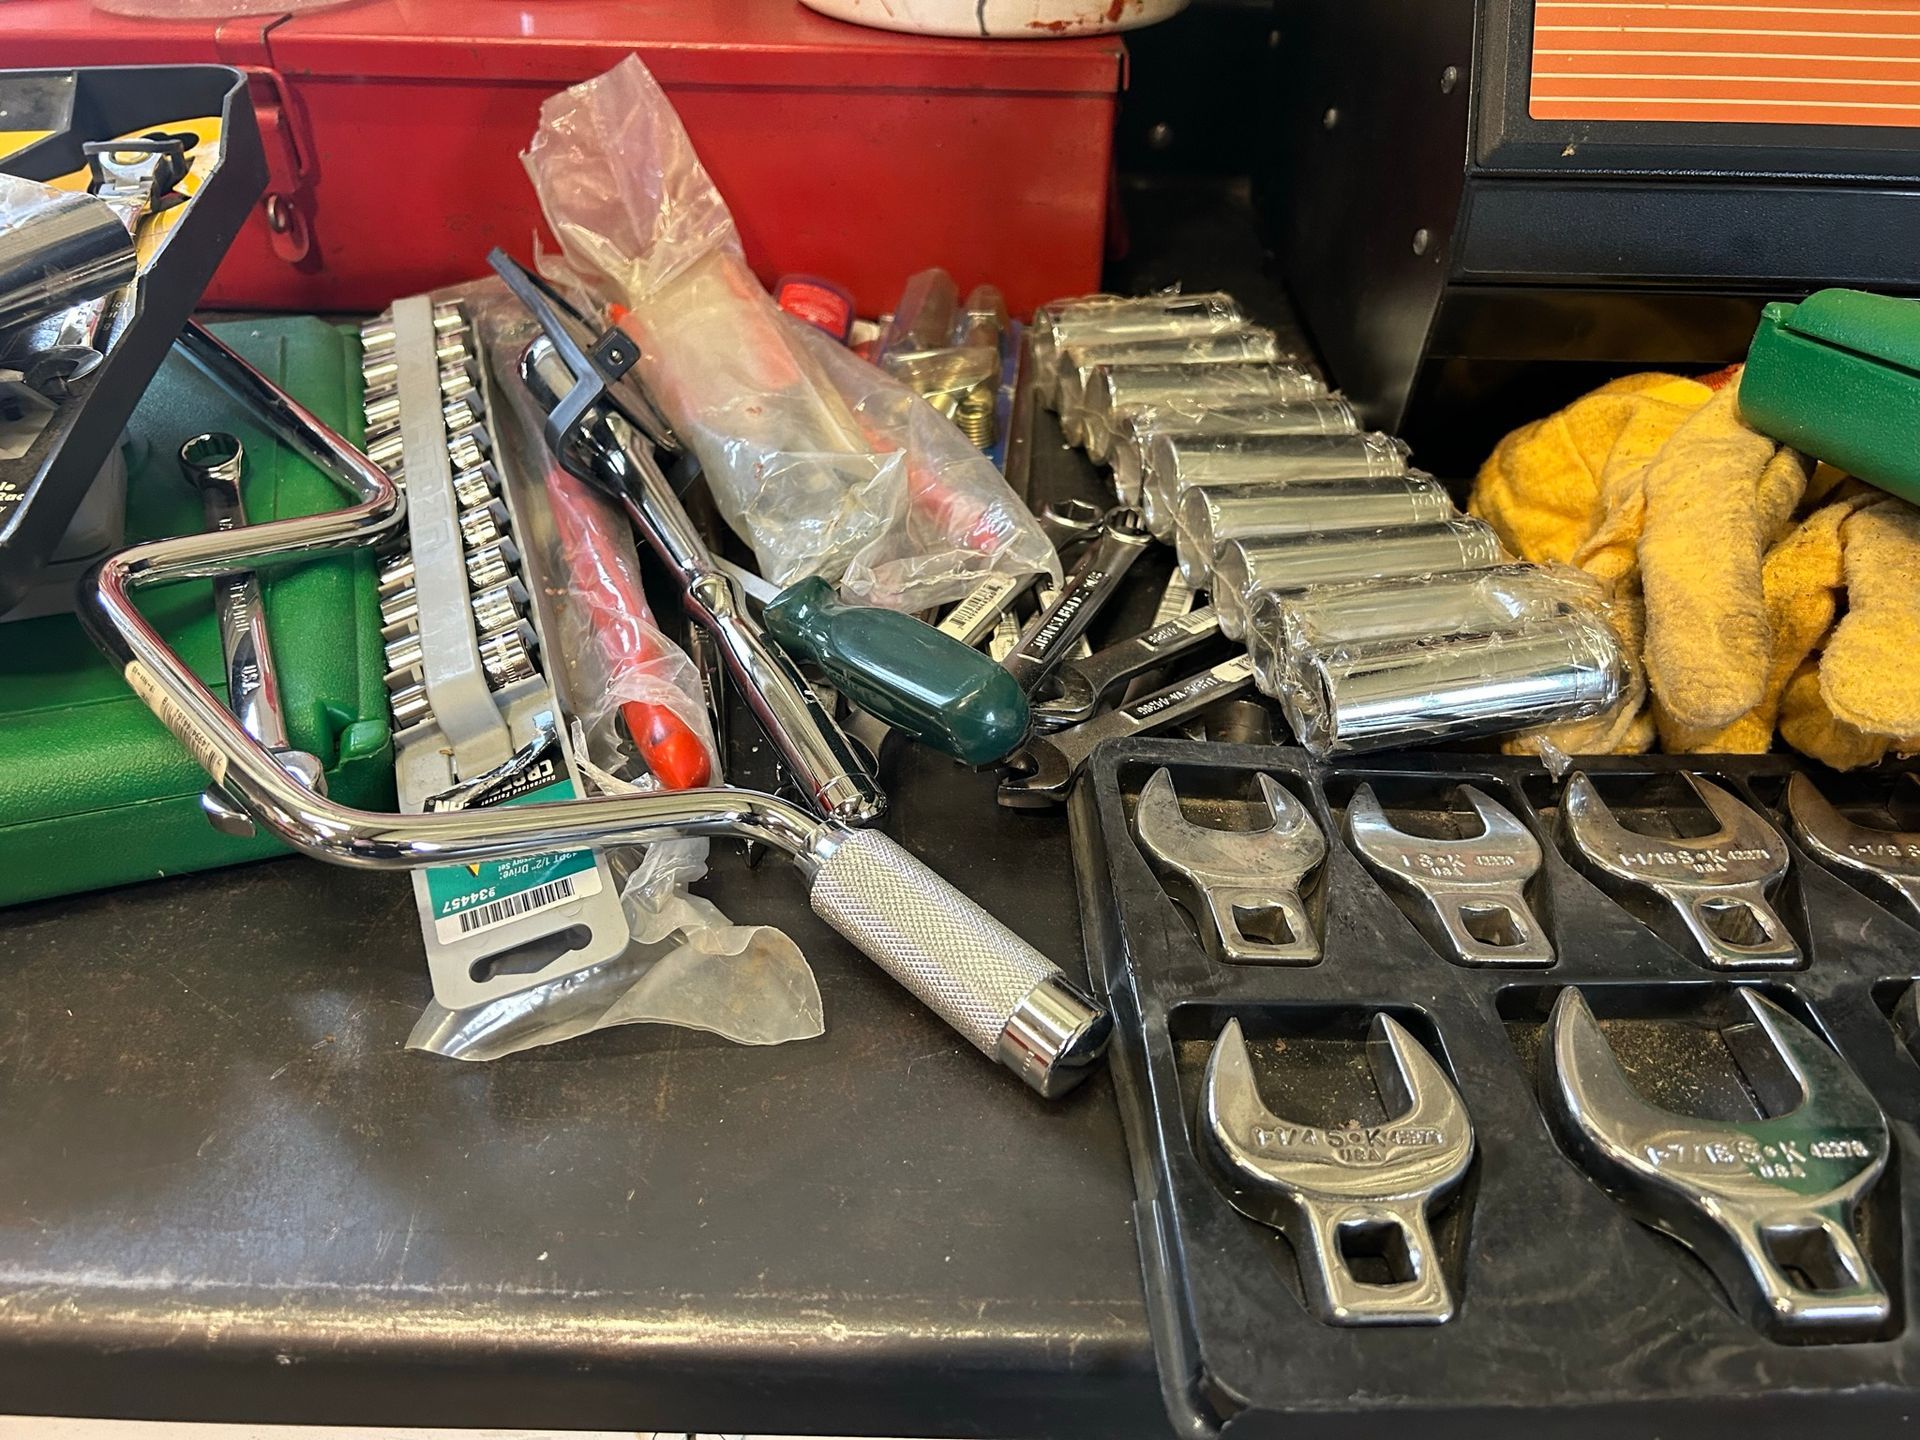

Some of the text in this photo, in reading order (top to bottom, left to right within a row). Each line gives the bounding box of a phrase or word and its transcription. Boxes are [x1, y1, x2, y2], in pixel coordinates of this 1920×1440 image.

[512, 774, 556, 795] Guaranteed
[498, 862, 511, 872] Set
[500, 864, 529, 880] Drive:
[1693, 863, 1727, 873] USA
[442, 886, 496, 913] 934457
[1339, 1148, 1382, 1162] USA
[1759, 1163, 1807, 1179] USA
